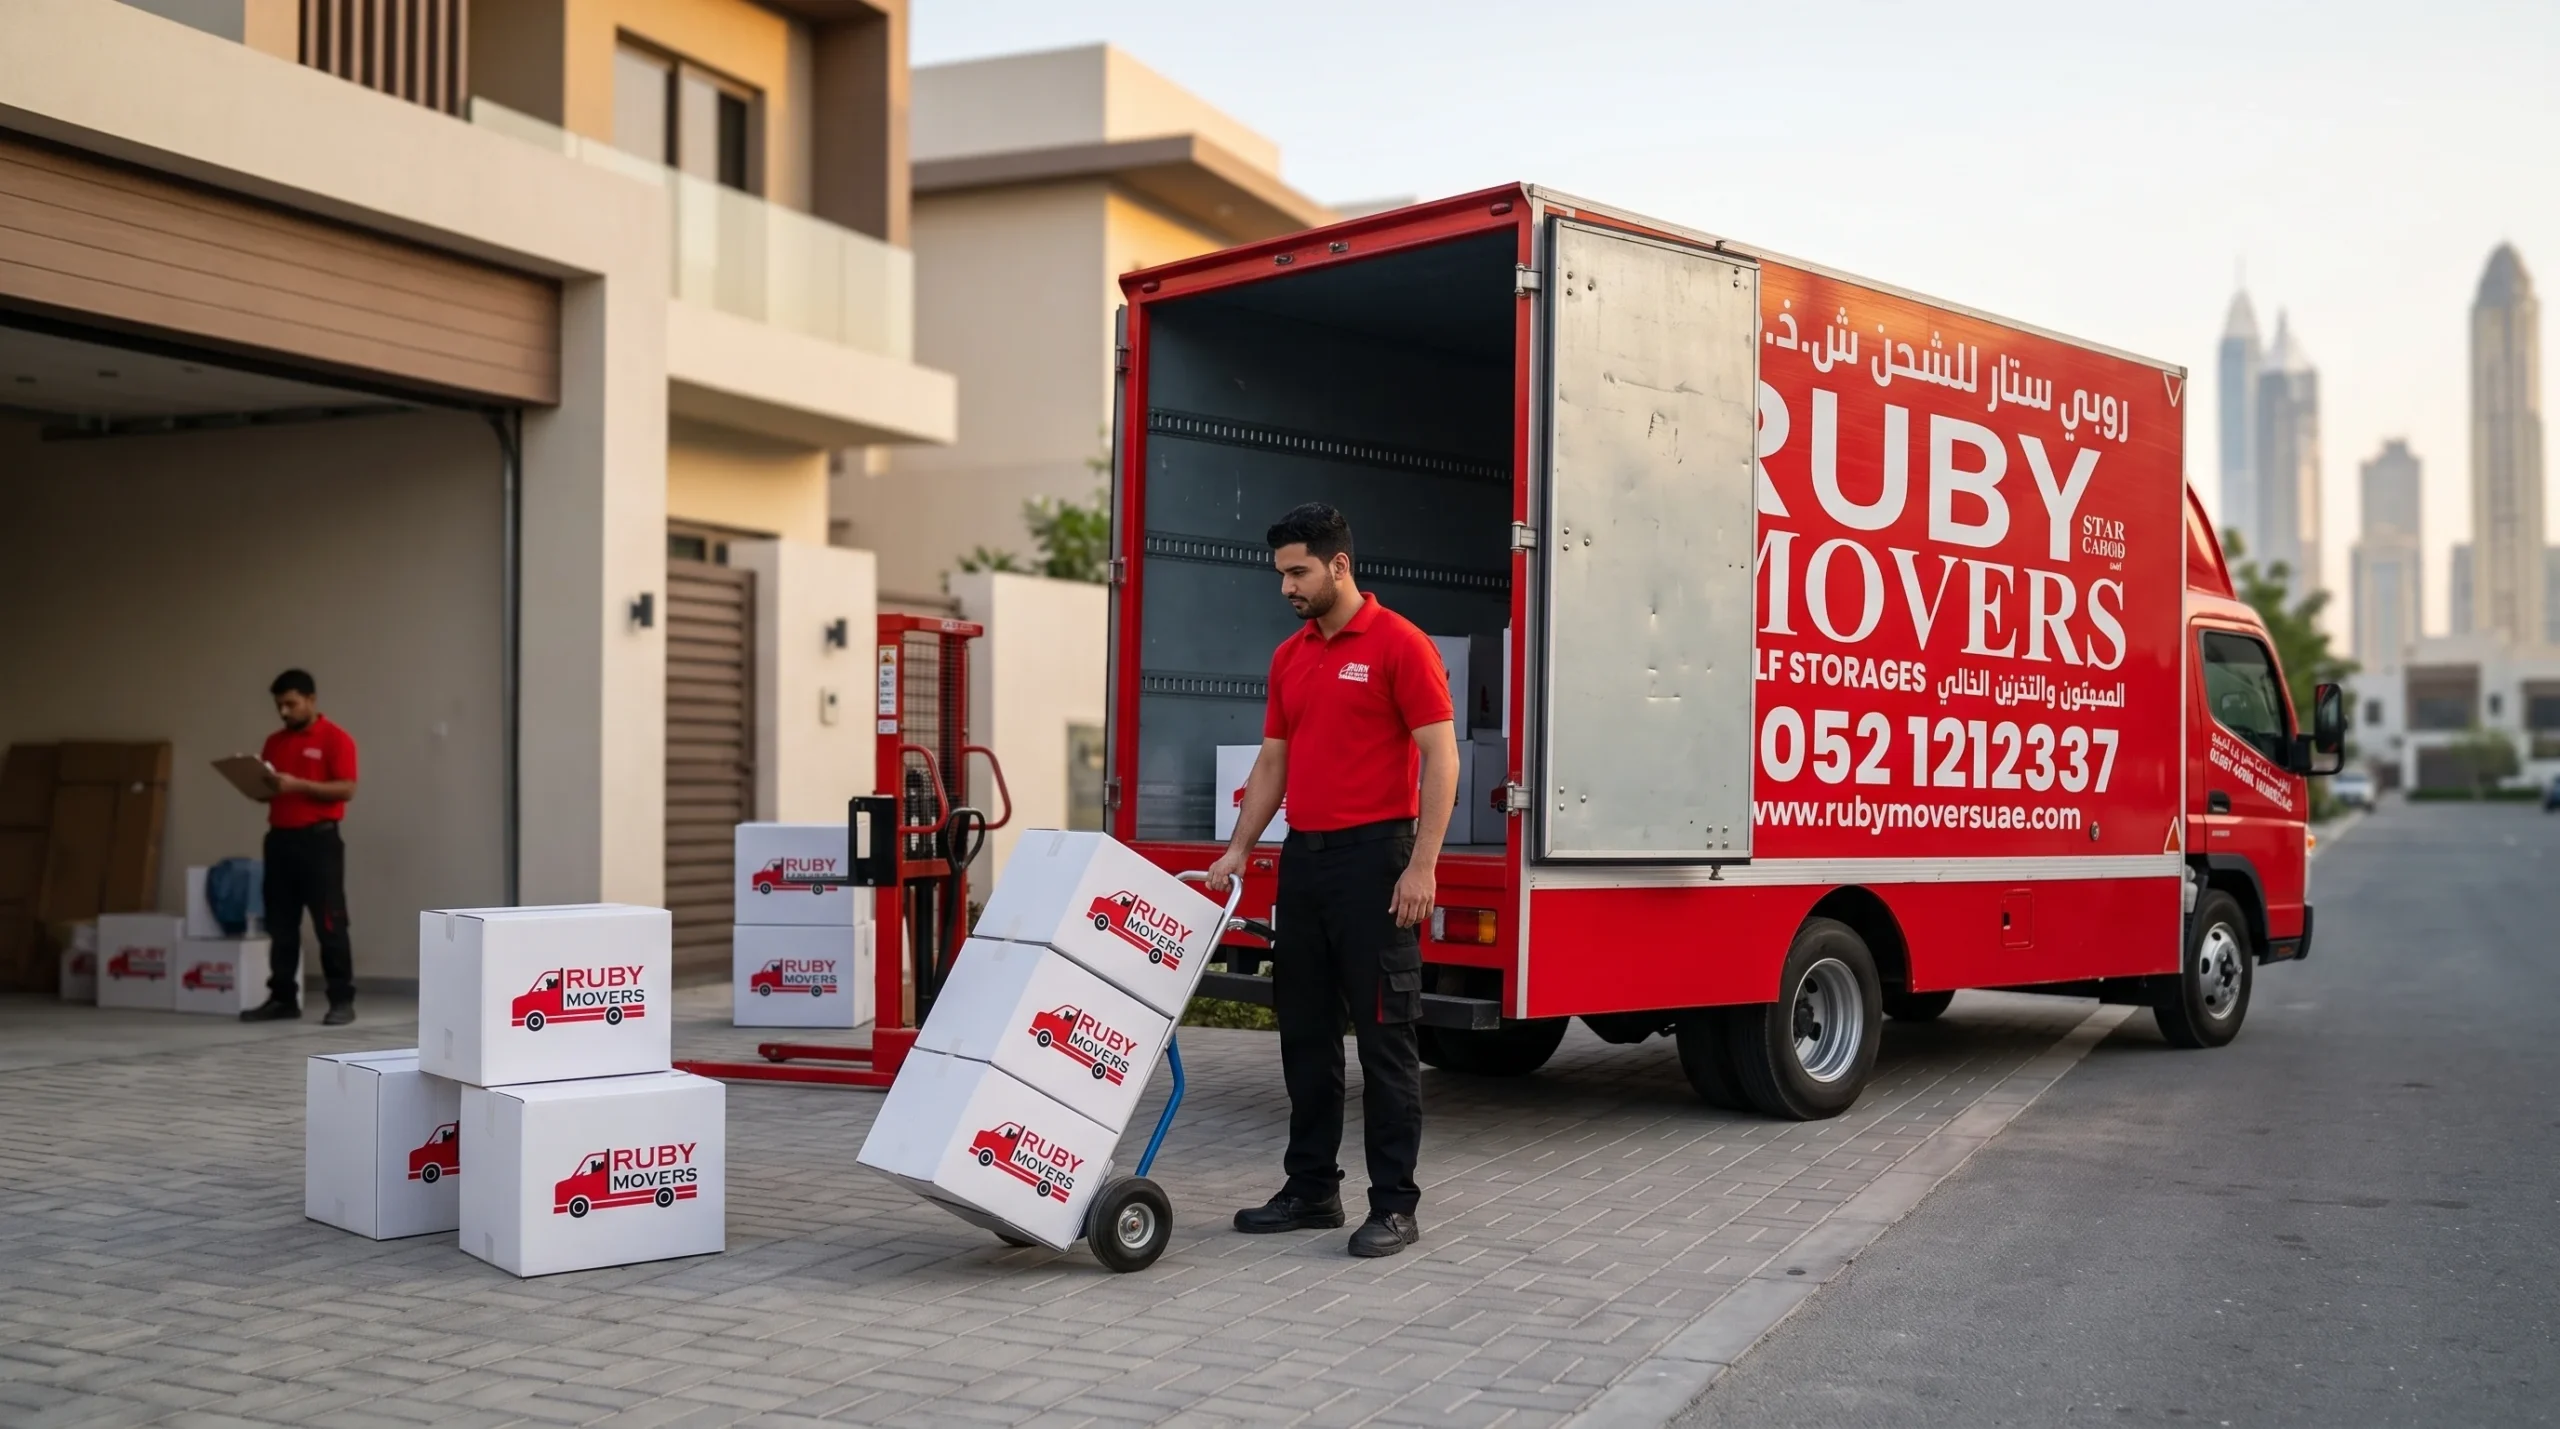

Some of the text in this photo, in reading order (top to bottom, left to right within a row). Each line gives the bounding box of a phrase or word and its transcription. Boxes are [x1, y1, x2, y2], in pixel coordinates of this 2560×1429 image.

[1871, 324, 1978, 393] للشحن
[1987, 354, 2052, 412] ستار
[2060, 389, 2129, 443] روبي
[2083, 514, 2126, 541] STAR
[1789, 651, 1927, 693] STORAGES
[1760, 705, 1892, 785] 052
[1908, 715, 2119, 794] 1212337
[784, 857, 837, 872] RUBY
[1126, 916, 1186, 959] MOVERS
[1133, 899, 1194, 944] RUBY
[565, 965, 645, 990] RUBY
[784, 959, 837, 973] RUBY
[784, 974, 838, 984] MOVERS
[565, 989, 645, 1008] MOVERS
[1070, 1031, 1131, 1075] MOVERS
[1077, 1012, 1138, 1056] RUBY
[612, 1142, 697, 1172] RUBY
[1012, 1150, 1075, 1190] MOVERS
[1020, 1130, 1084, 1174] RUBY
[613, 1167, 698, 1191] MOVERS
